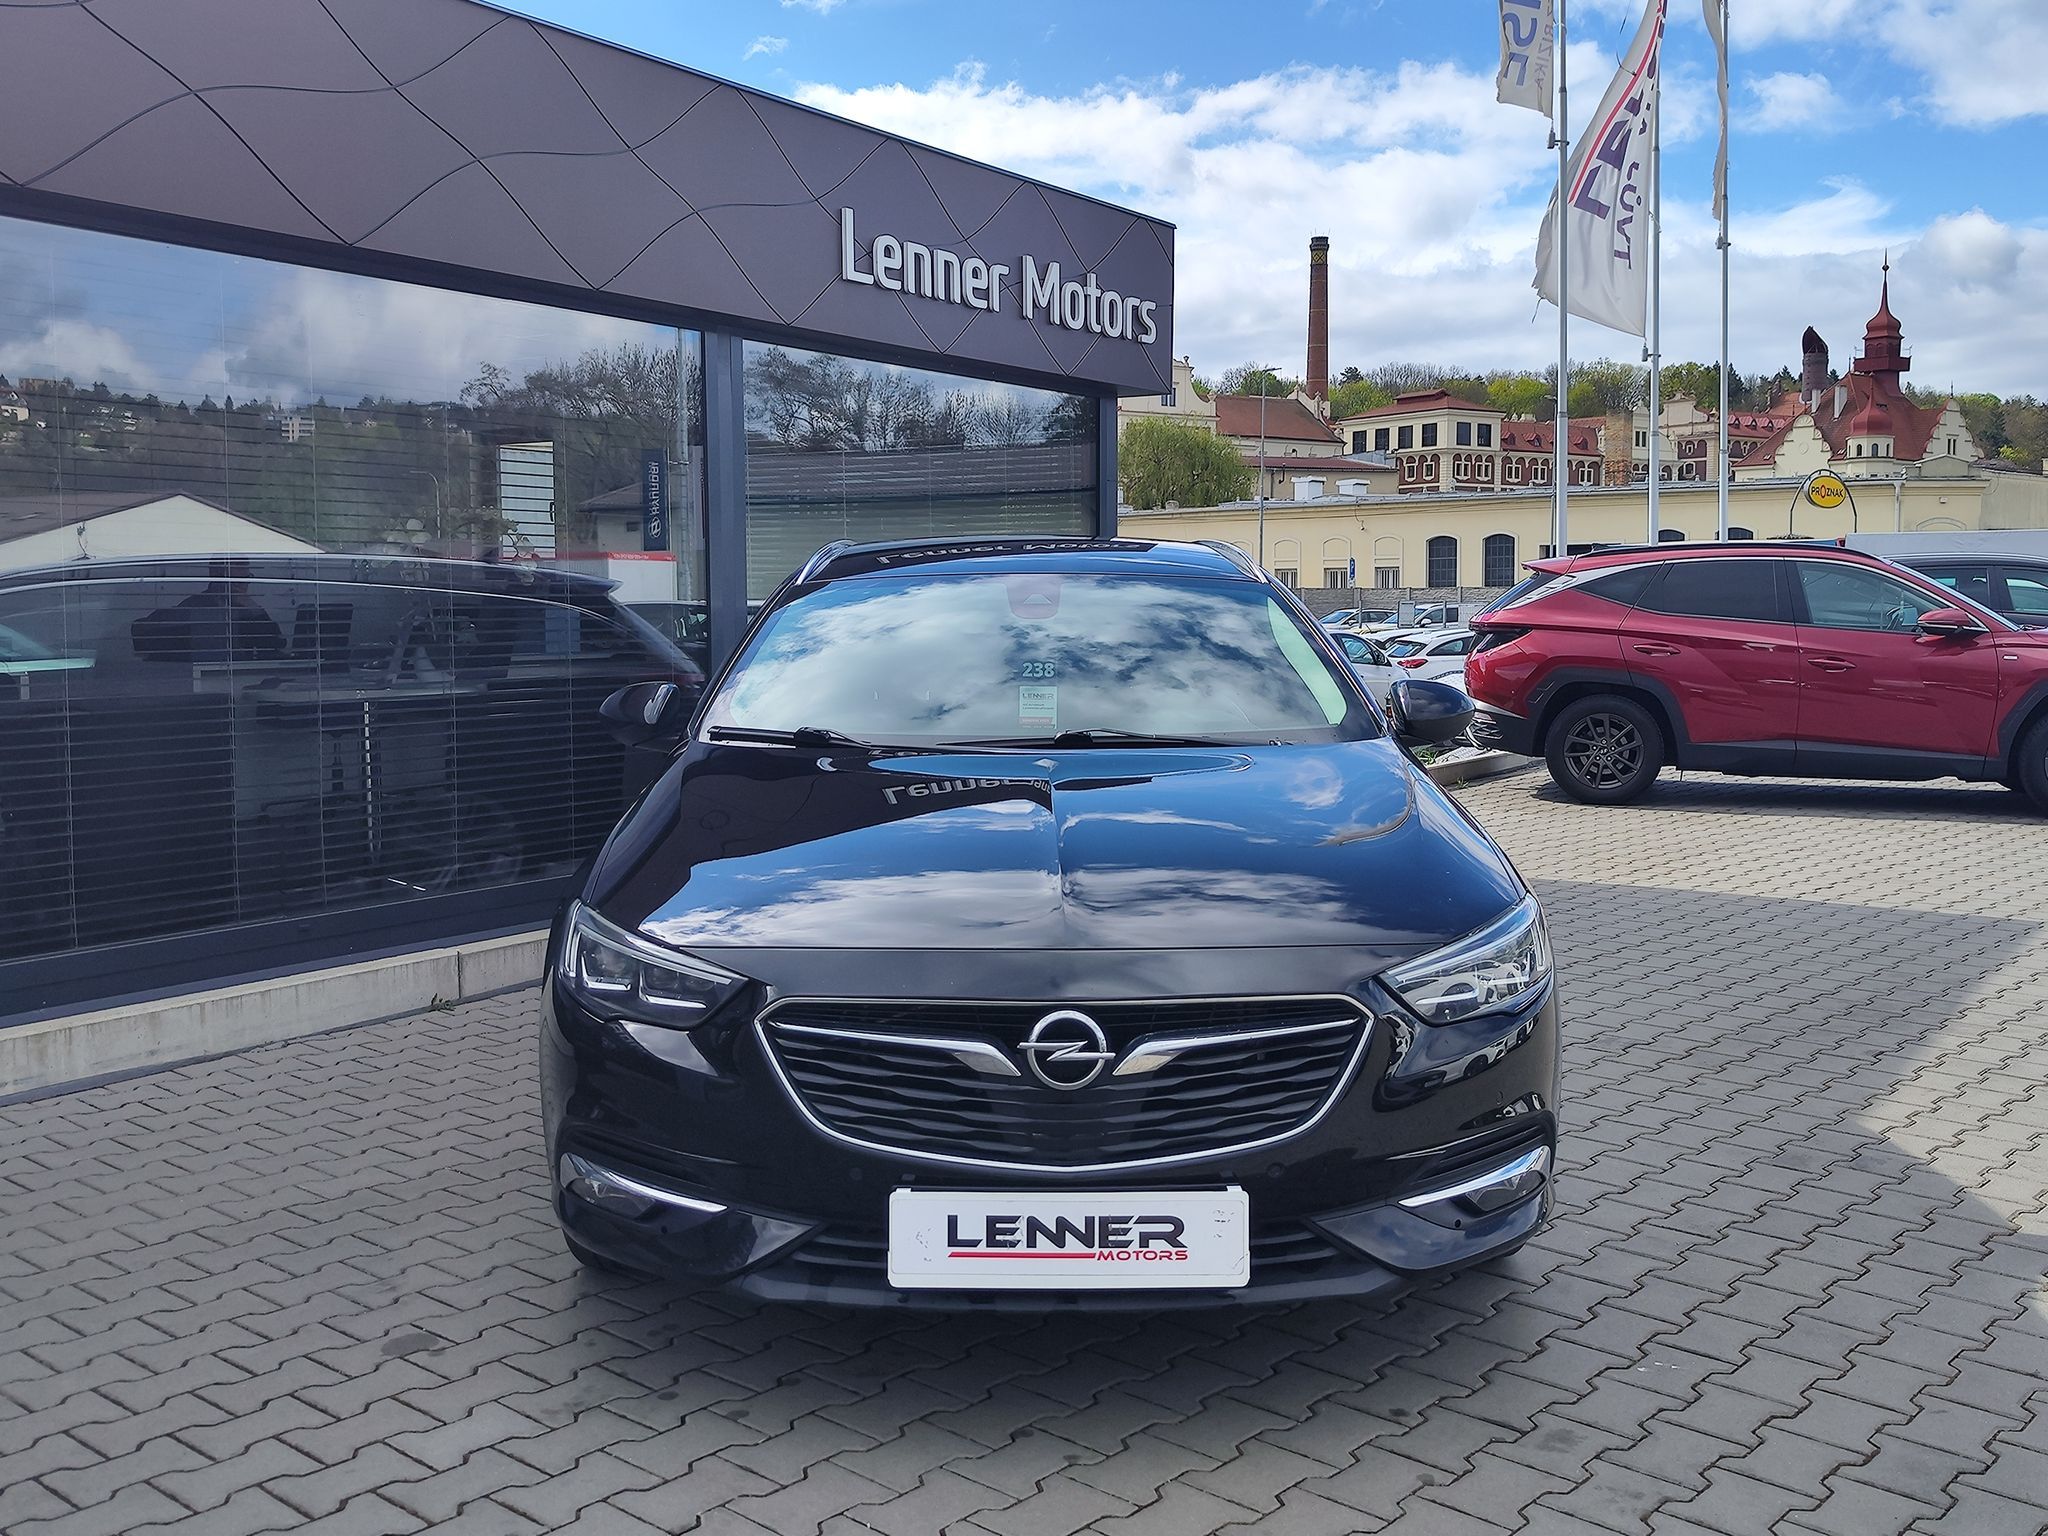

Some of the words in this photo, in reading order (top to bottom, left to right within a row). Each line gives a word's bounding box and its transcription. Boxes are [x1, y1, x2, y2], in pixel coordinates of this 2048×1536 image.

[841, 206, 1009, 313] Lenner
[1022, 254, 1157, 345] Motors
[1811, 485, 1843, 499] PROZNAK
[1022, 662, 1055, 678] 238
[947, 1214, 1188, 1249] LENNER
[1096, 1249, 1189, 1262] MOTORS
